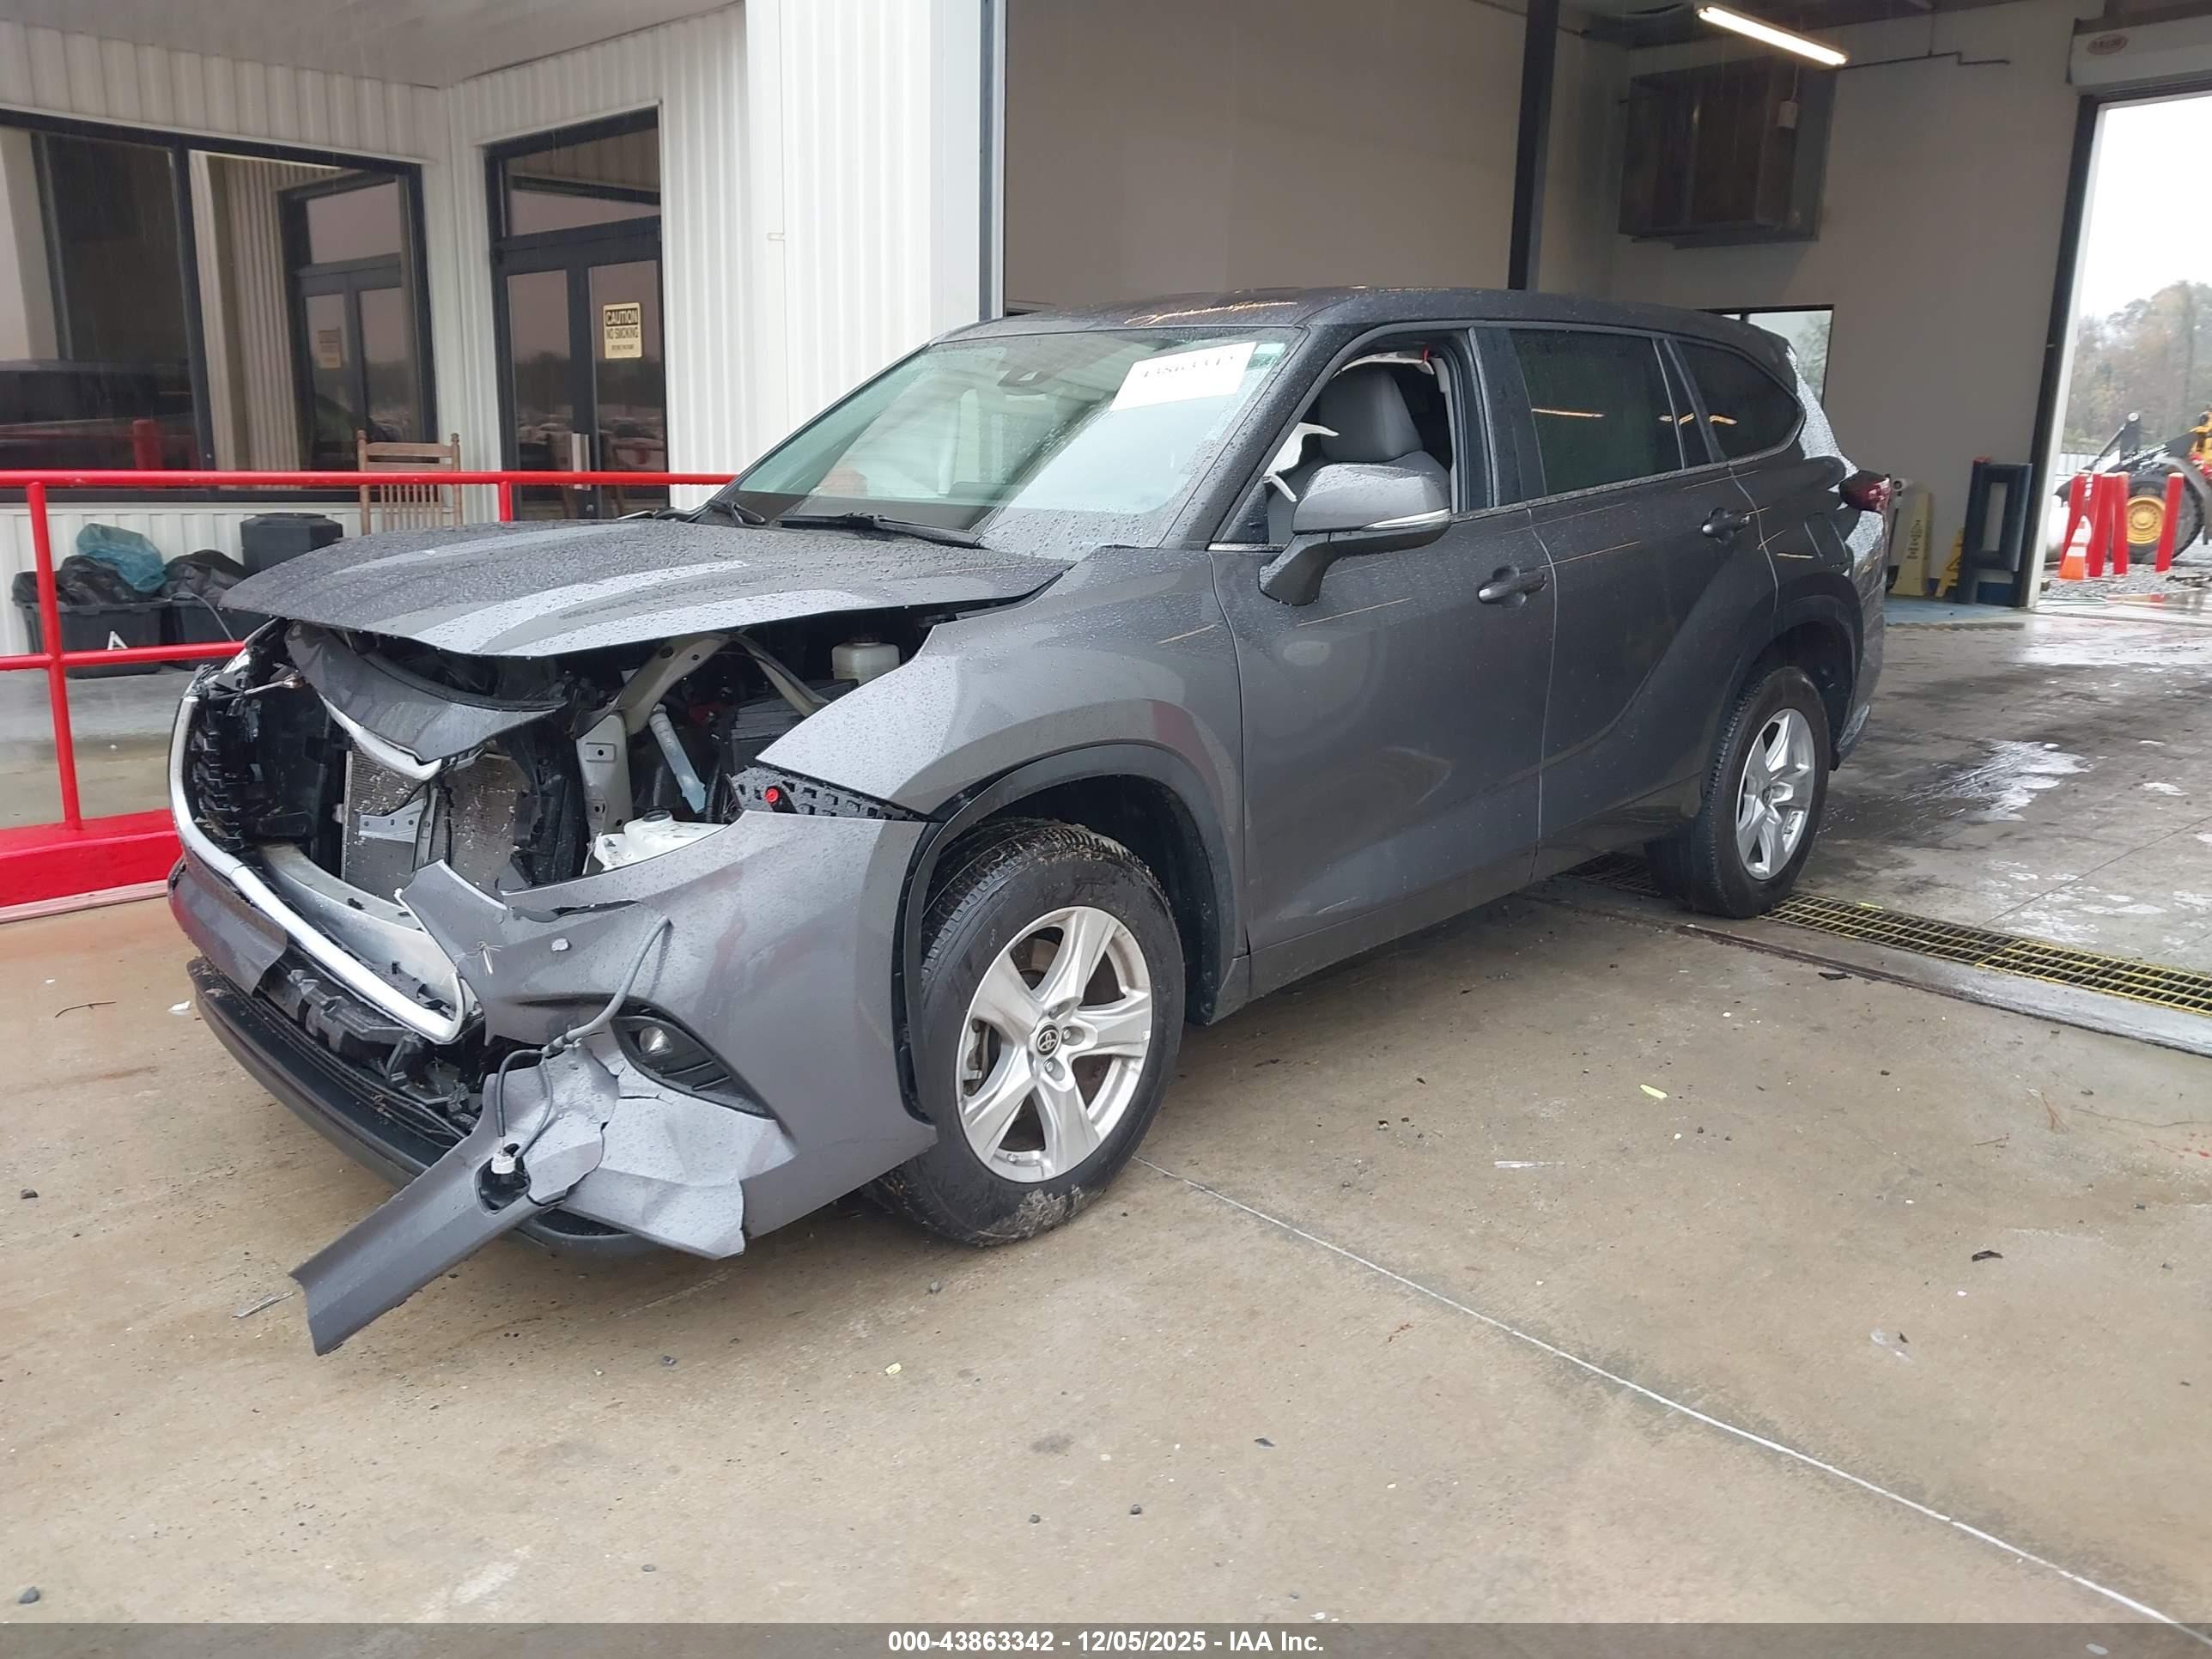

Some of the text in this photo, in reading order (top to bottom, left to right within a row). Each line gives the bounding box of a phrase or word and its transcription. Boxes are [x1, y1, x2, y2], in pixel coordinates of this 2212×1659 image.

[605, 309, 638, 325] CAUTION
[605, 327, 639, 339] NO SMOKING
